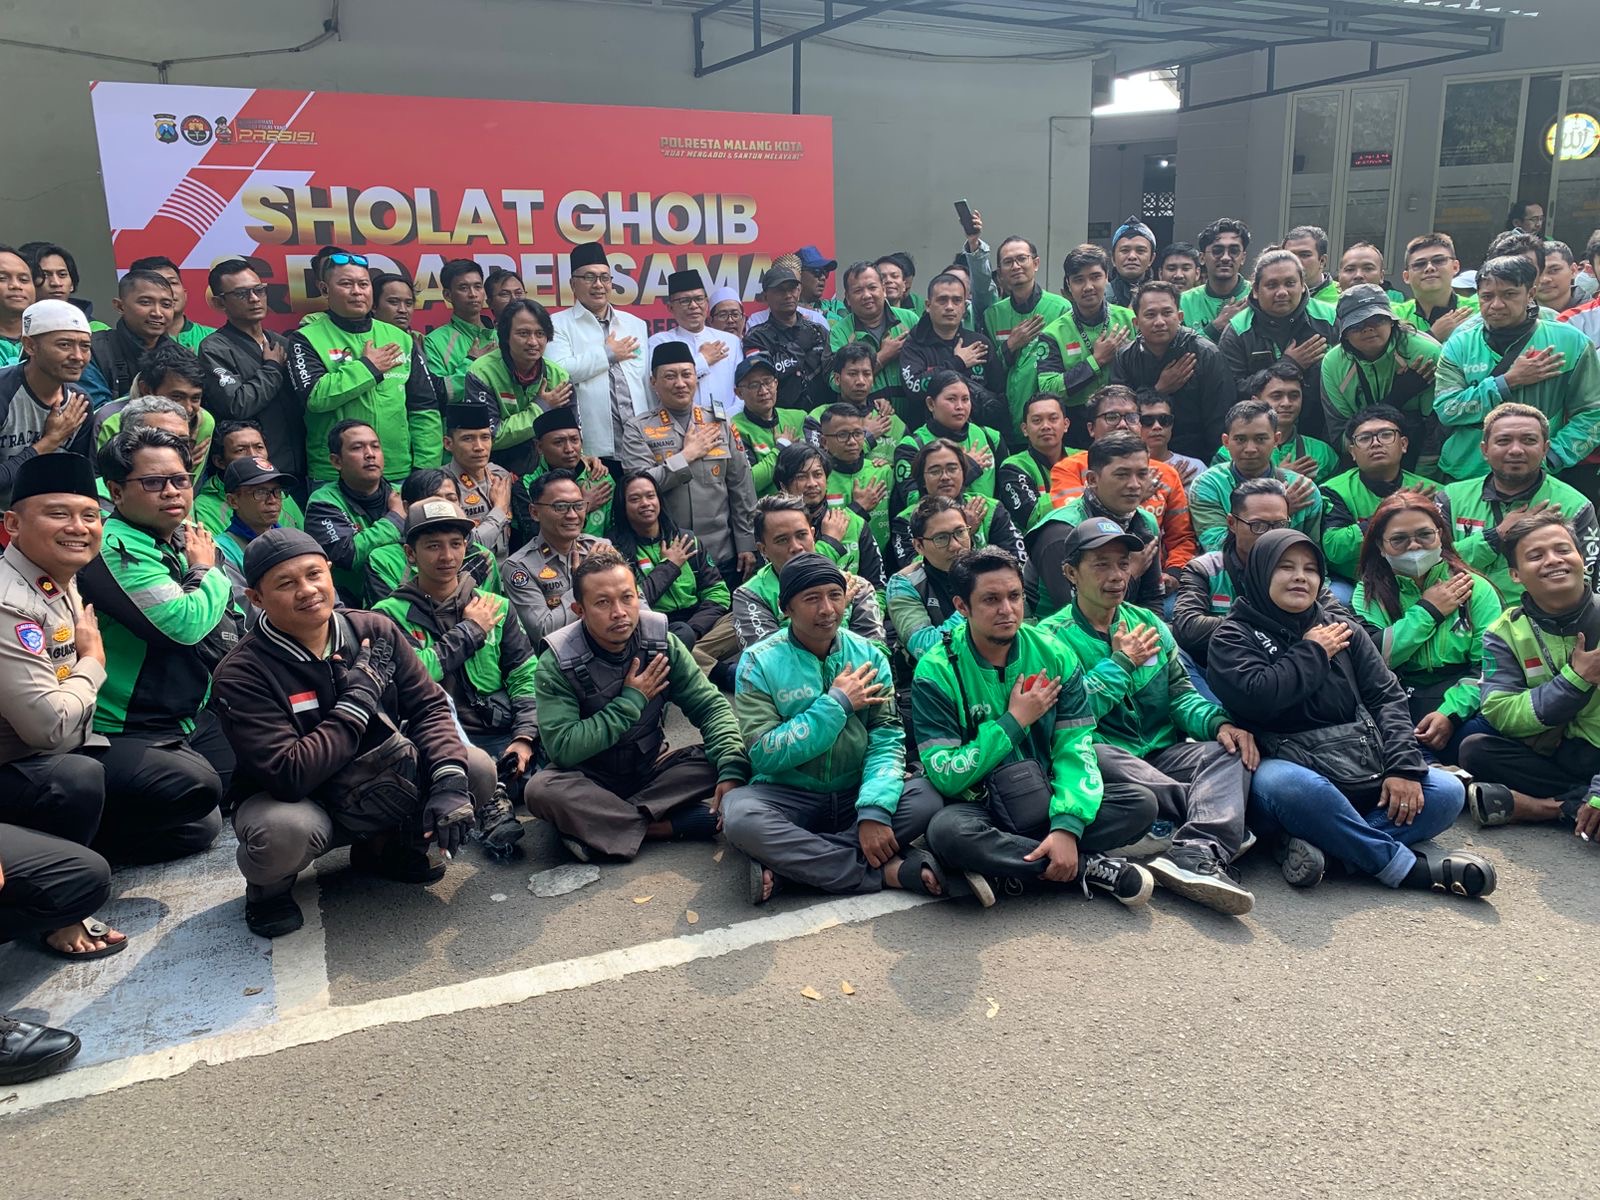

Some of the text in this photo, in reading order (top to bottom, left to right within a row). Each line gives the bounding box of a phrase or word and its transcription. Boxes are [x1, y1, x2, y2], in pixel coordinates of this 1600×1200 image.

[659, 136, 804, 152] POLRESTA MALANG KOTA
[241, 184, 760, 246] SHOLAT GHOIB
[776, 683, 815, 703] Grab
